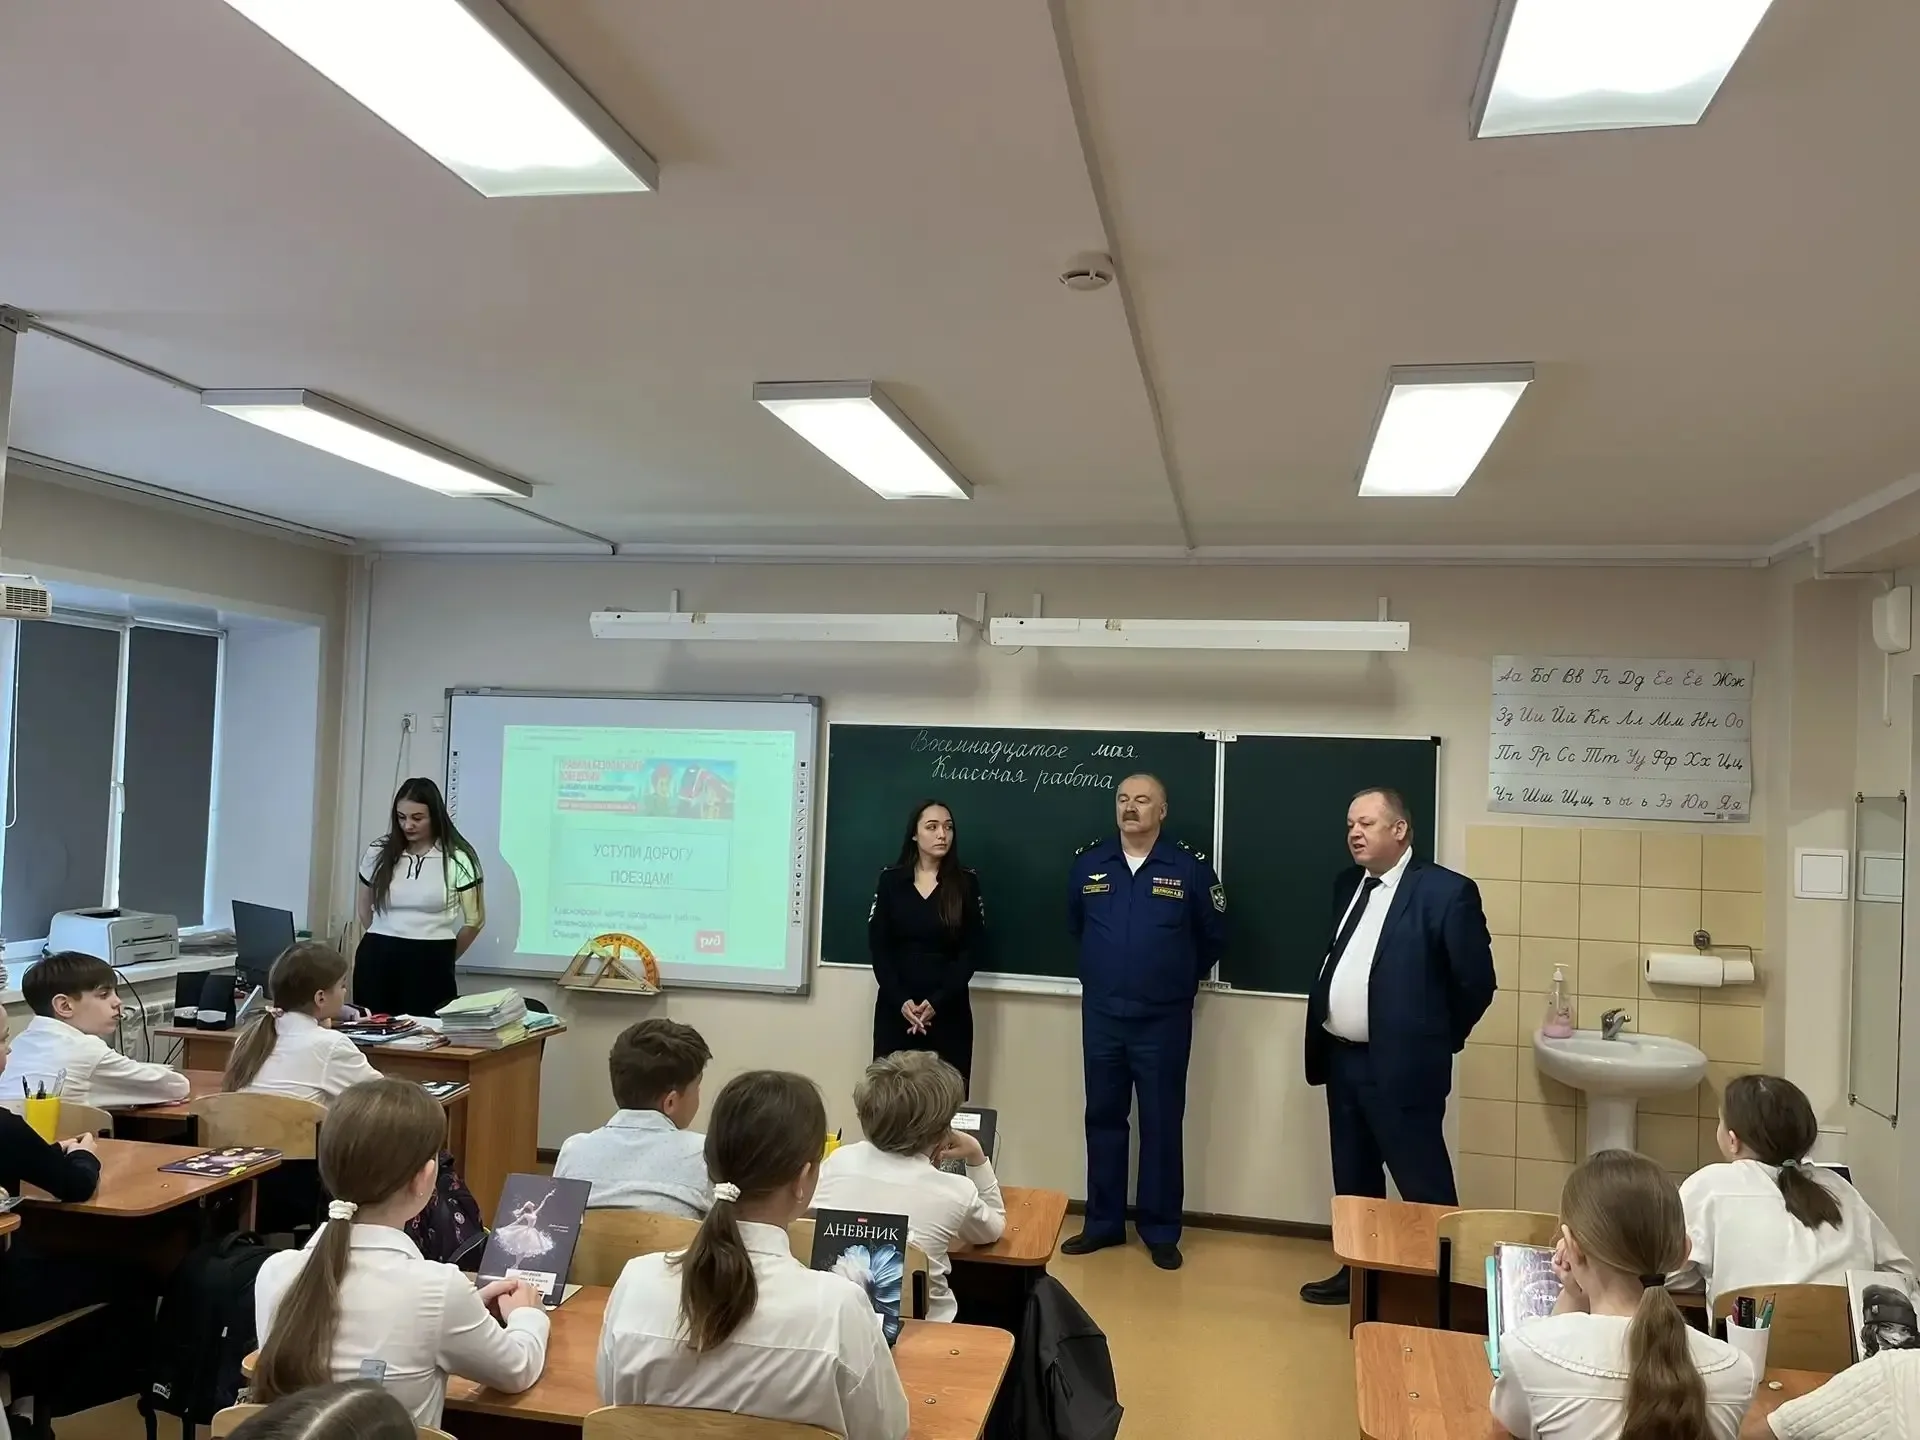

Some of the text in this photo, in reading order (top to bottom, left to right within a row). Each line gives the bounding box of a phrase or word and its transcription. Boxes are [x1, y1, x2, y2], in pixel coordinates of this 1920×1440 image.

[1497, 667, 1523, 682] Аа
[1531, 668, 1558, 683] Бб
[1562, 668, 1584, 683] Вв
[1592, 669, 1611, 684] Гг
[1618, 670, 1645, 691] Дд
[1653, 670, 1673, 685] Ее
[1712, 671, 1745, 687] Жж
[1497, 705, 1744, 728] Зз Ии Йй Кк Лл Мм Нн Оо
[911, 729, 1069, 764] Восемнадцатое
[1495, 744, 1743, 771] Пп Рр Сс Тт Уу Фф Хх Цц
[932, 755, 1028, 783] Классная
[1493, 785, 1514, 801] Чч
[1522, 787, 1554, 803] Шш
[1561, 789, 1594, 806] Щщ
[1656, 793, 1673, 808] Ээ
[1680, 793, 1709, 810] Юю
[1717, 794, 1742, 810] Яя
[593, 844, 694, 862] УСТУПИ ДОРОГУ
[610, 870, 674, 887] ПОЕЗДАМ!
[823, 1222, 900, 1241] ДНЕВНИК
